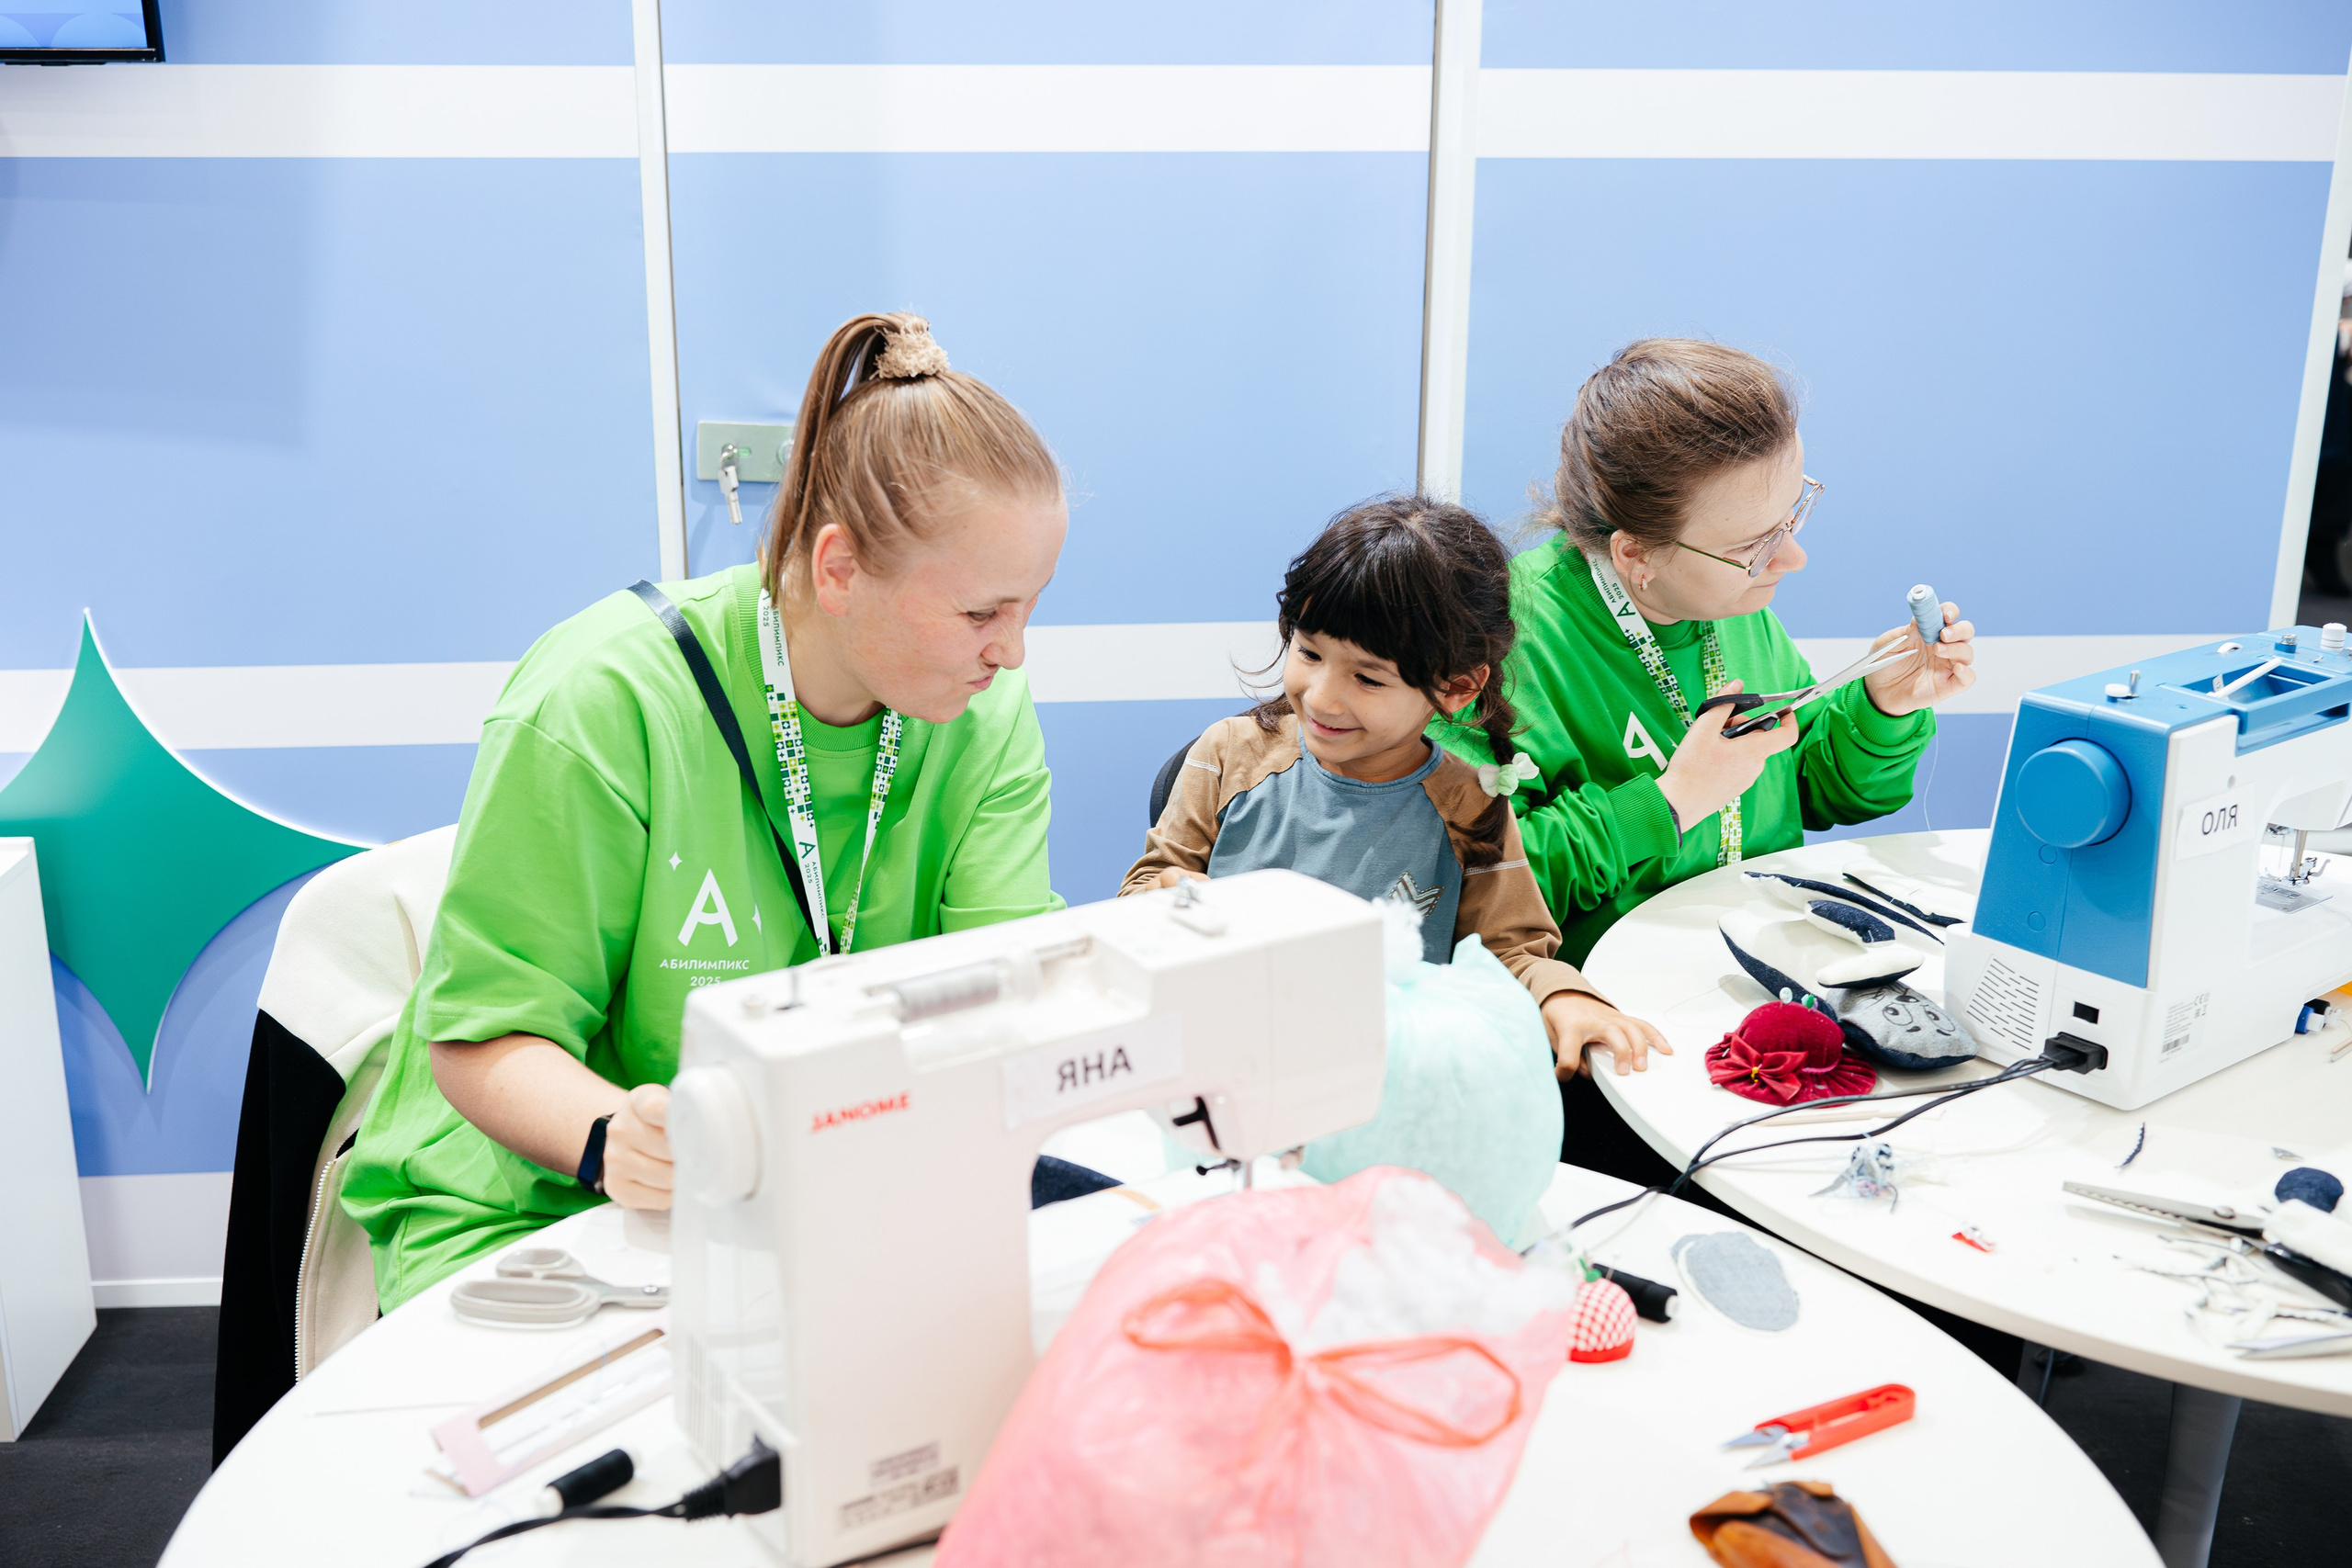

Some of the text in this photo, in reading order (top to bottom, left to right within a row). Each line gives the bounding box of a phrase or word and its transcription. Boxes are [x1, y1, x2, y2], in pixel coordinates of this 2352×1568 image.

[1592, 558, 1617, 604] АБИЛИМПИКС
[1612, 582, 1624, 600] 2025
[2201, 804, 2239, 836] ОЛЯ
[804, 863, 813, 884] 2025
[812, 861, 826, 919] АБИЛИМПИКС
[677, 867, 739, 948] А
[660, 958, 751, 970] АБИЛИМПИКС
[690, 976, 721, 987] 2025
[1057, 1046, 1133, 1092] ЯНА
[810, 1091, 910, 1133] JANOME
